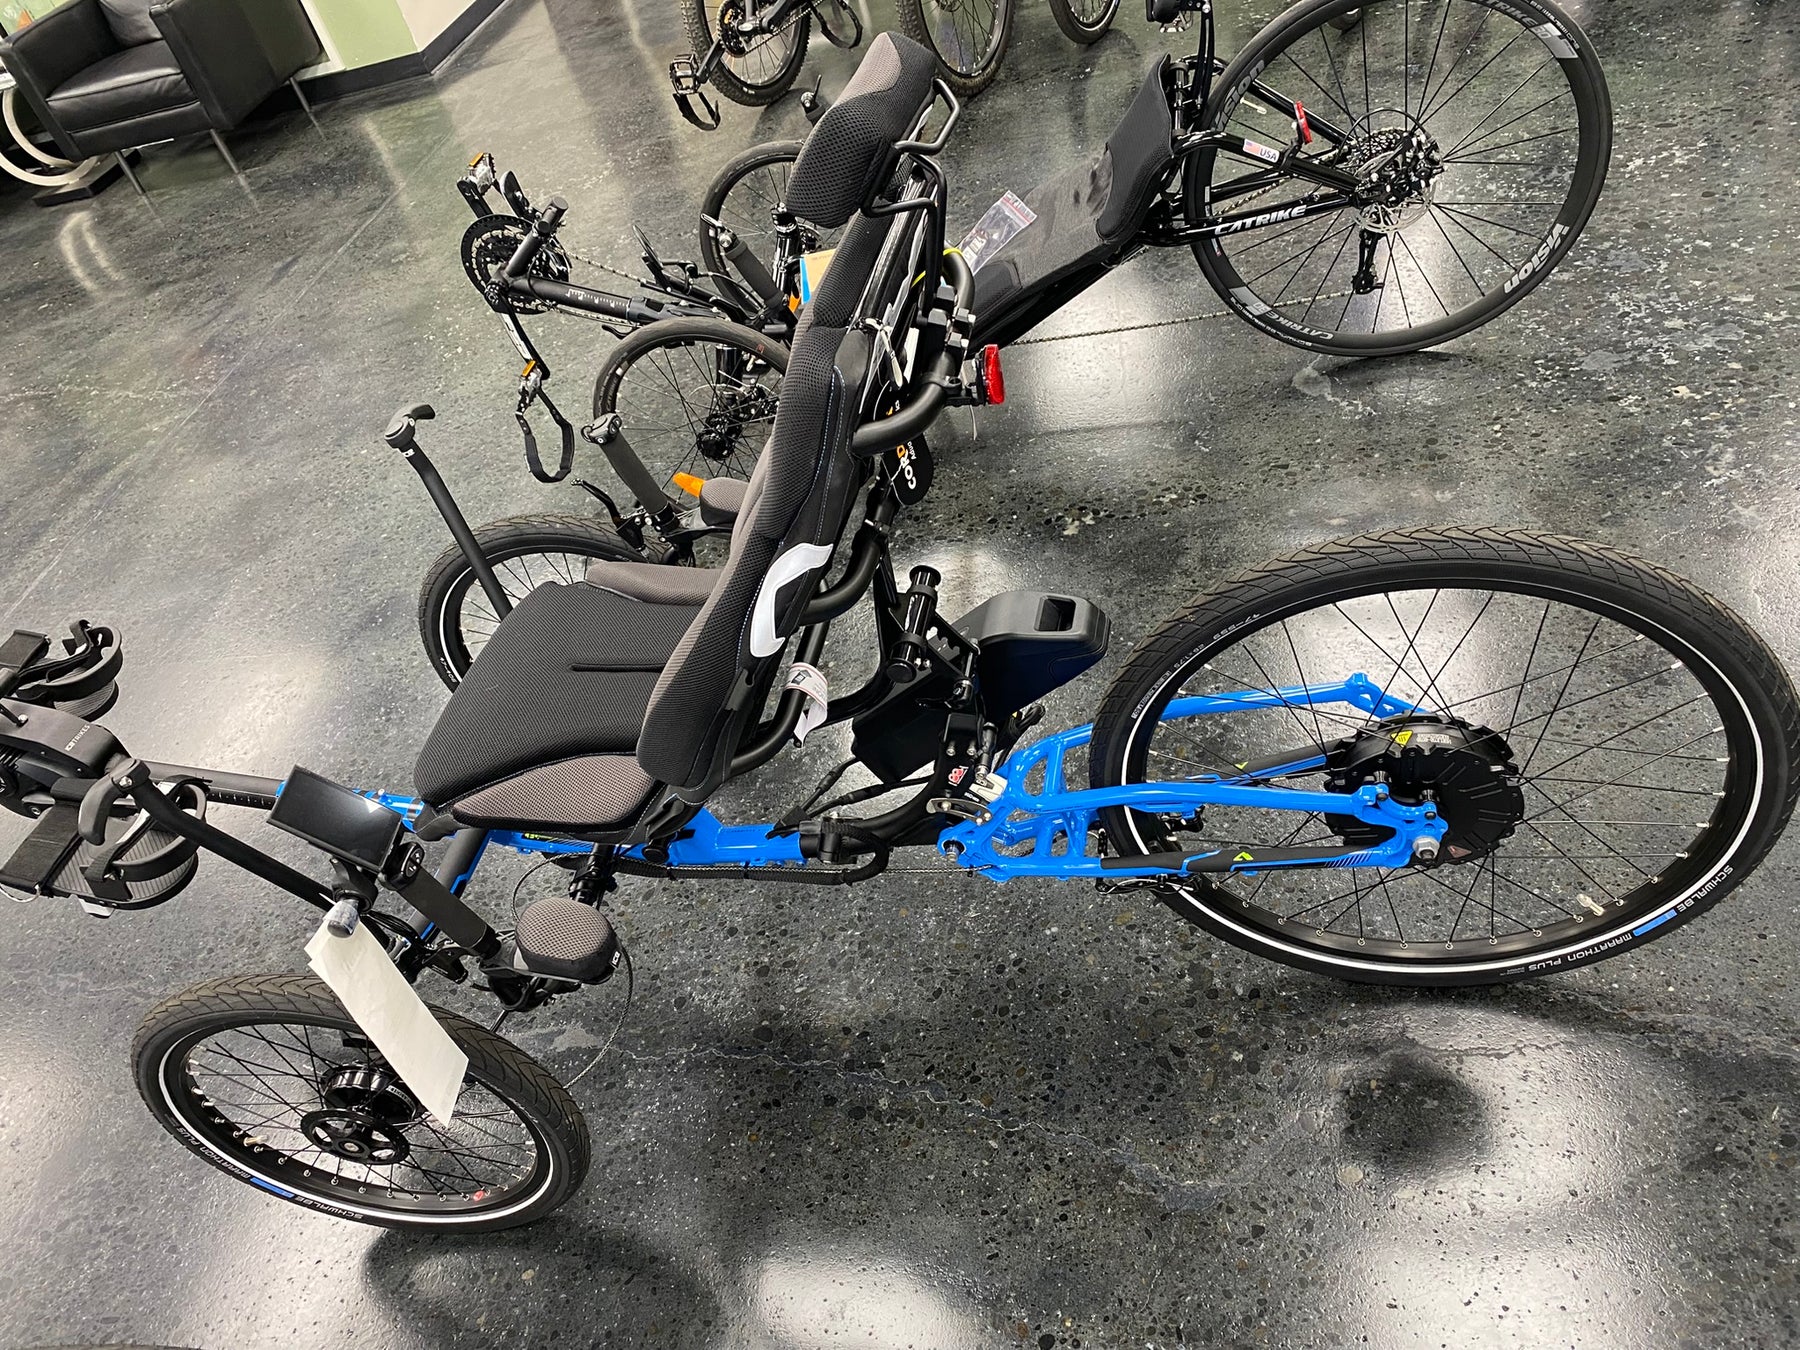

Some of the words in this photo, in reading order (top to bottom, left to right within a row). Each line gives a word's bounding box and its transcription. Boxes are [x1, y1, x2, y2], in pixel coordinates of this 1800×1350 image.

[1259, 148, 1278, 161] USA
[1214, 204, 1307, 235] CATRIKE
[1503, 223, 1570, 294] Vision
[1265, 310, 1334, 340] CATRIKE
[896, 444, 917, 490] CORD
[1676, 864, 1734, 913] SCHWALBE
[1567, 932, 1633, 962] MARATHON
[1528, 957, 1562, 972] PLUS
[176, 1126, 201, 1146] PLUS
[199, 1146, 252, 1179] MARATHON
[294, 1195, 364, 1220] SCHWALBE
